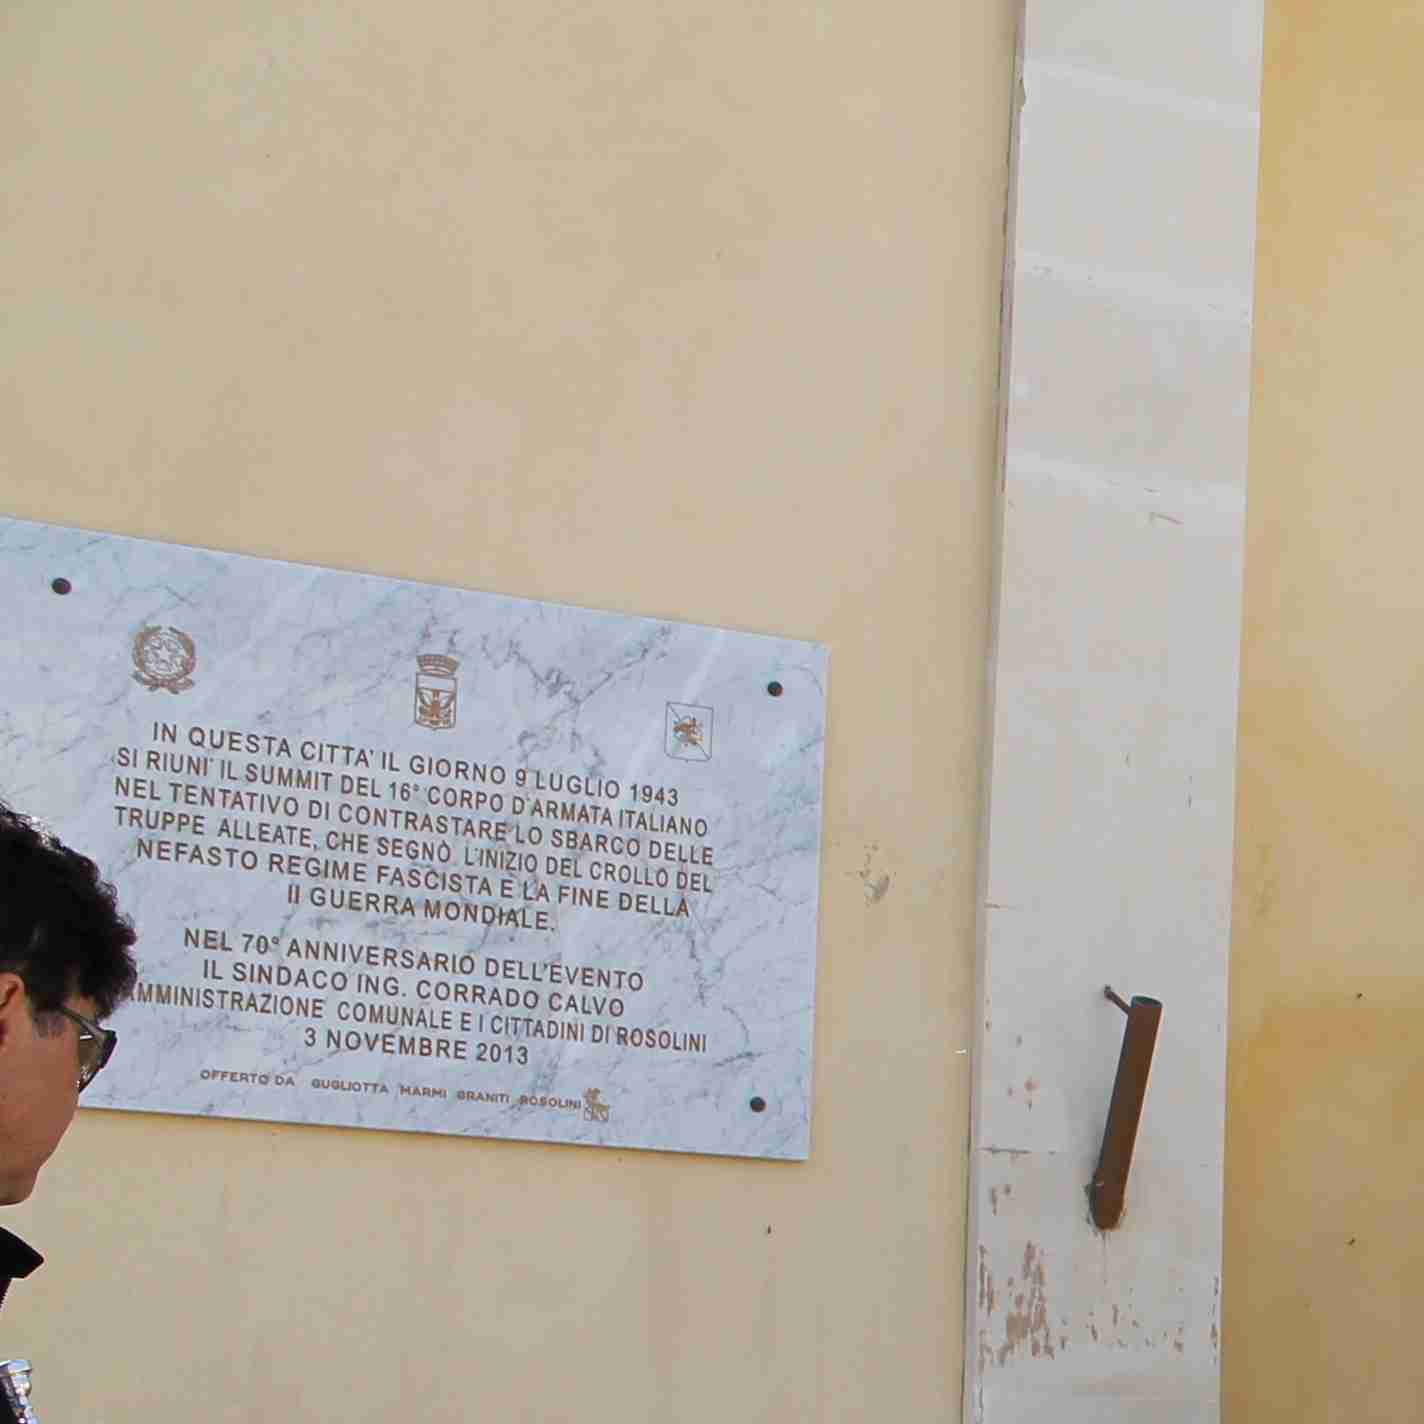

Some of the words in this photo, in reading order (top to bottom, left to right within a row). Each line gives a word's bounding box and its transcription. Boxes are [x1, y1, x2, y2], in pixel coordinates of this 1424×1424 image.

[117, 746, 137, 768] SI
[220, 759, 242, 781] IL
[244, 762, 333, 792] SUMMIT
[340, 773, 382, 799] DEL
[428, 785, 504, 813] CORPO
[512, 795, 613, 827] D'ARMATA
[618, 808, 707, 837] ITALIANO
[153, 721, 177, 744] IN
[187, 726, 292, 759] QUESTA
[381, 751, 400, 772] IL
[408, 754, 506, 784] GIORNO
[515, 766, 528, 788] 9
[535, 769, 621, 799] LUGLIO
[629, 783, 678, 808] 1943
[115, 775, 160, 801] NEL
[169, 781, 301, 817] TENTATIVO
[309, 799, 330, 820] DI
[338, 802, 507, 843] CONTRASTARE
[515, 820, 543, 845] LO
[550, 828, 641, 858] SBARCO
[649, 839, 713, 866] DELLE
[115, 805, 205, 835] TRUPPE
[325, 830, 368, 854] CHE
[464, 845, 538, 878] L'INIZIO
[545, 854, 583, 879] DEL
[589, 858, 669, 889] CROLLO
[676, 866, 712, 893] DEL
[136, 837, 258, 870] NEFASTO
[268, 852, 368, 883] REGIME
[376, 864, 493, 896] FASCISTA
[500, 878, 513, 899] E
[523, 877, 550, 902] LA
[557, 883, 611, 909] FINE
[618, 888, 690, 917] DELLA
[309, 886, 415, 917] GUERRA
[184, 927, 233, 952] NEL
[286, 938, 474, 975] ANNIVERSARIO
[484, 956, 643, 992] DELL'EVENTO
[203, 958, 223, 980] IL
[232, 961, 349, 991] SINDACO
[356, 973, 406, 997] ING.
[415, 979, 540, 1010] CORRADO
[548, 991, 624, 1018] CALVO
[304, 1026, 316, 1047] 3
[326, 1028, 468, 1060] NOVEMBRE
[475, 1042, 528, 1065] 2013
[337, 1000, 453, 1030] COMUNALE
[459, 1011, 473, 1031] E
[479, 1013, 484, 1032] I
[490, 1014, 585, 1041] CITTADINI
[591, 1023, 610, 1043] DI
[615, 1025, 707, 1052] ROSOLINI
[200, 1068, 271, 1085] OFFERTO
[274, 1074, 295, 1086] DA
[311, 1078, 389, 1094] GUGLIOTTA
[399, 1082, 446, 1098] MARMI
[456, 1089, 510, 1103] GRANITI
[519, 1091, 582, 1110] ROSOLINI
